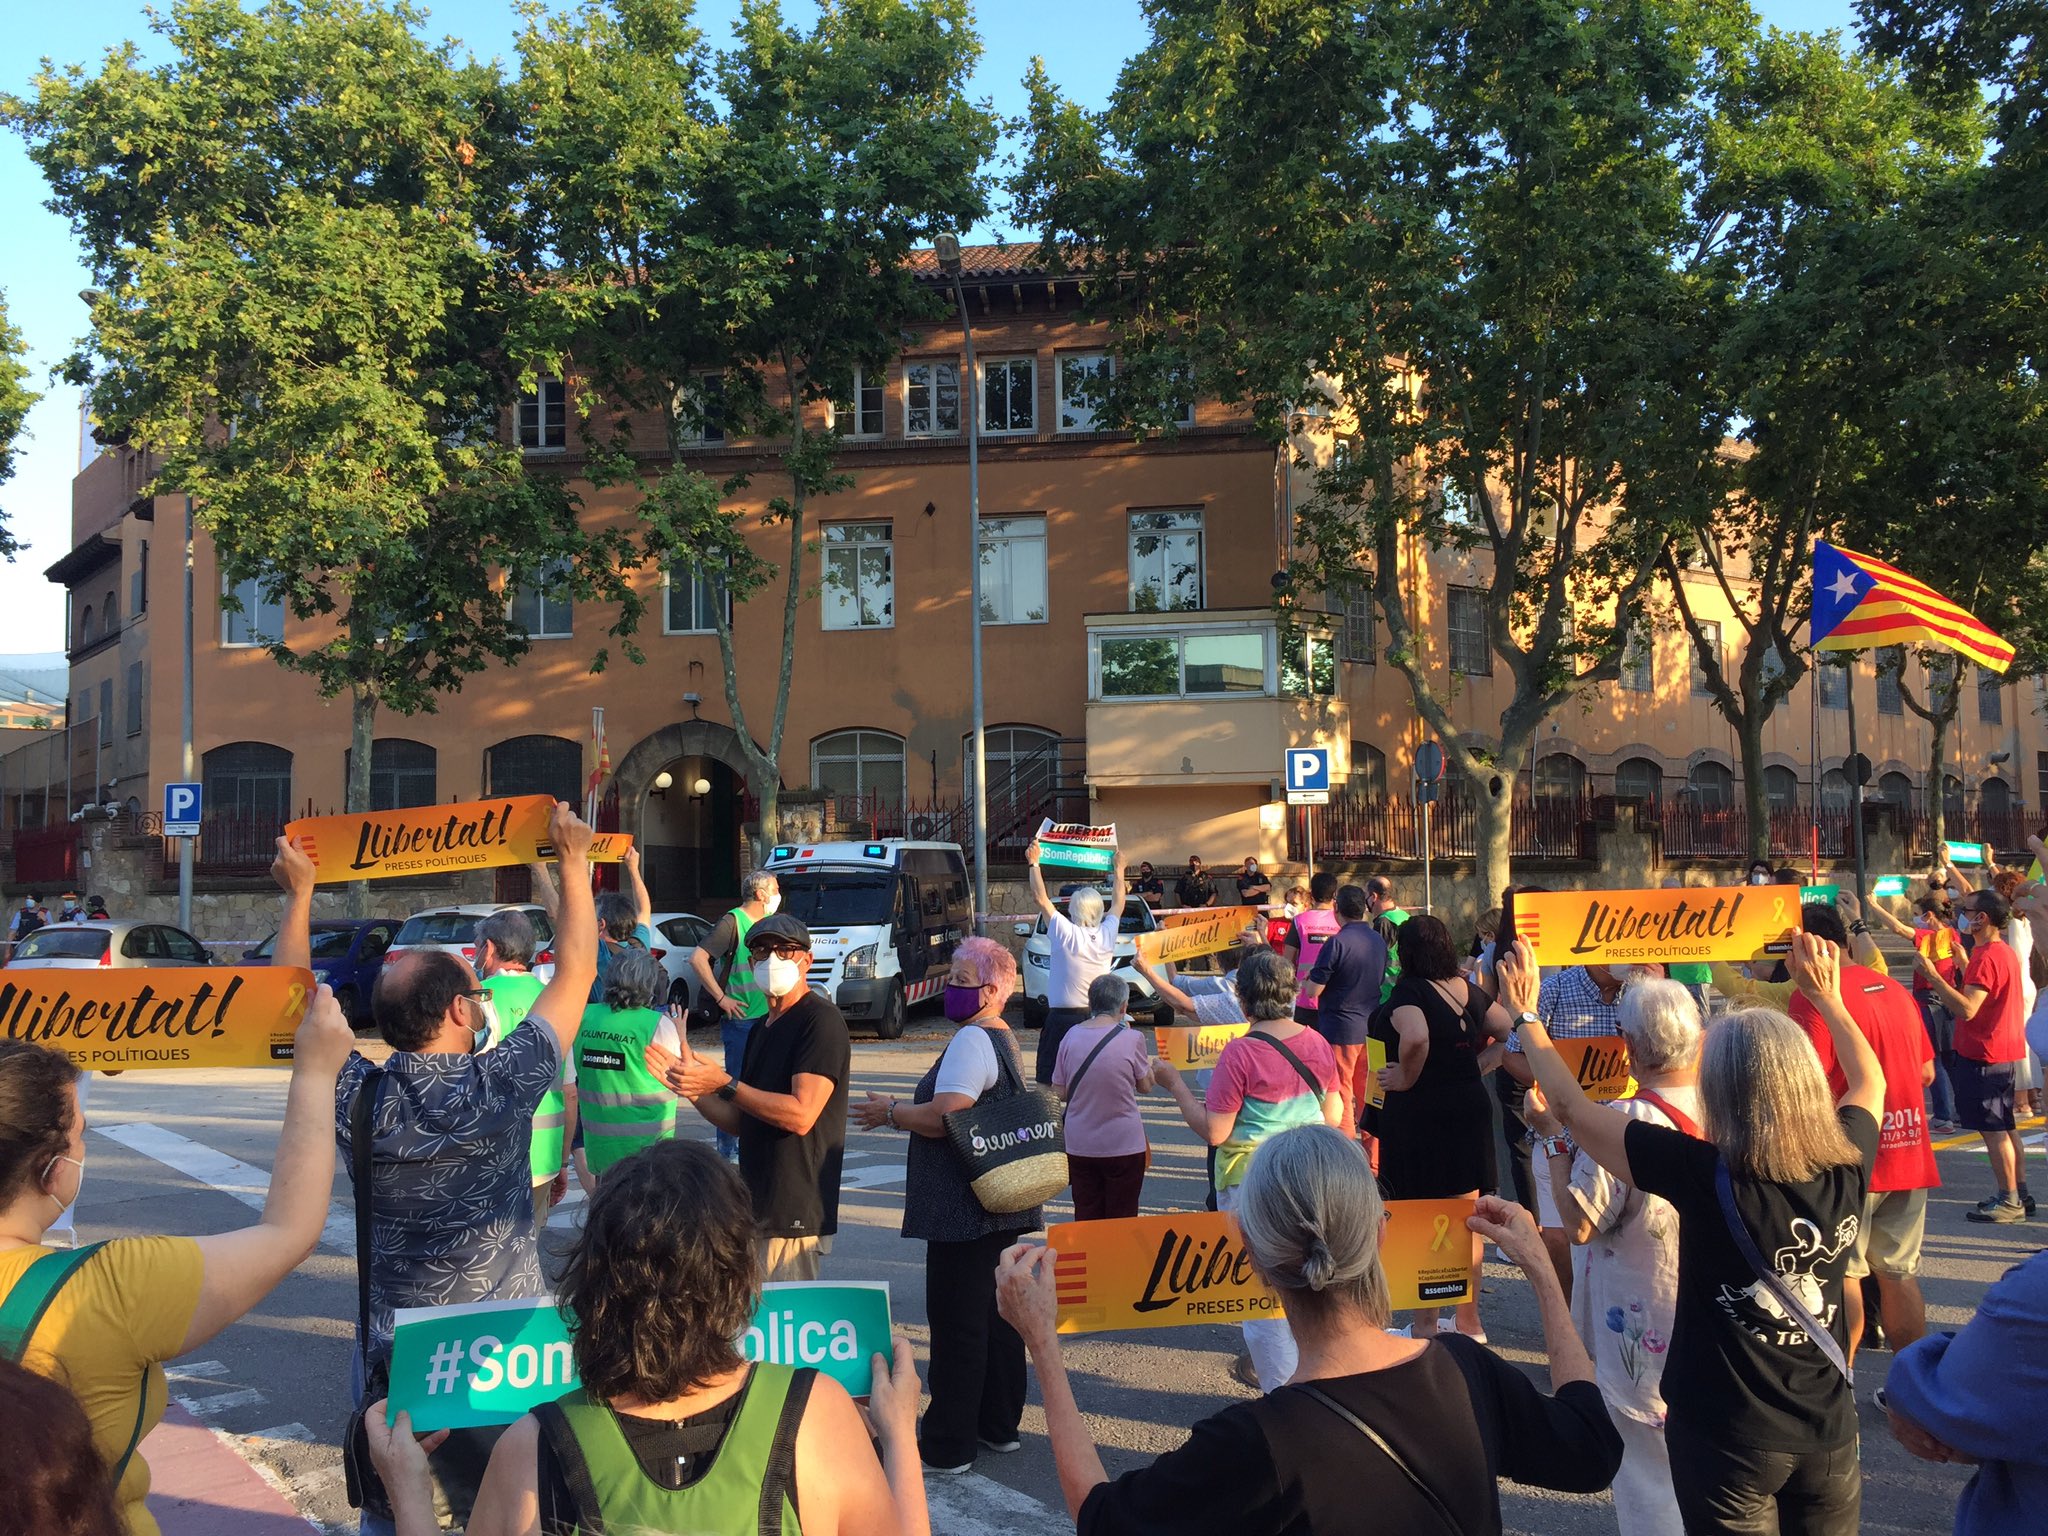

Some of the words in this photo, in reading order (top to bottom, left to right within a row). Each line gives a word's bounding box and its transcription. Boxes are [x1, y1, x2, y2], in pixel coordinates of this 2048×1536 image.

[1293, 753, 1320, 787] P
[172, 788, 194, 819] P
[349, 803, 513, 871] Llibertat!
[384, 859, 424, 872] PRESES
[425, 853, 487, 868] POLÍTIQUES
[1569, 892, 1744, 954] Llibertat!
[1158, 921, 1220, 960] Llibertat!
[1605, 947, 1645, 958] PRESES
[1647, 943, 1711, 958] POLÍTIQUES
[92, 1047, 190, 1063] POLÍTIQUES
[1883, 1106, 1921, 1130] 2014
[1424, 1283, 1463, 1295] assemblea
[1186, 1298, 1244, 1315] PRESES
